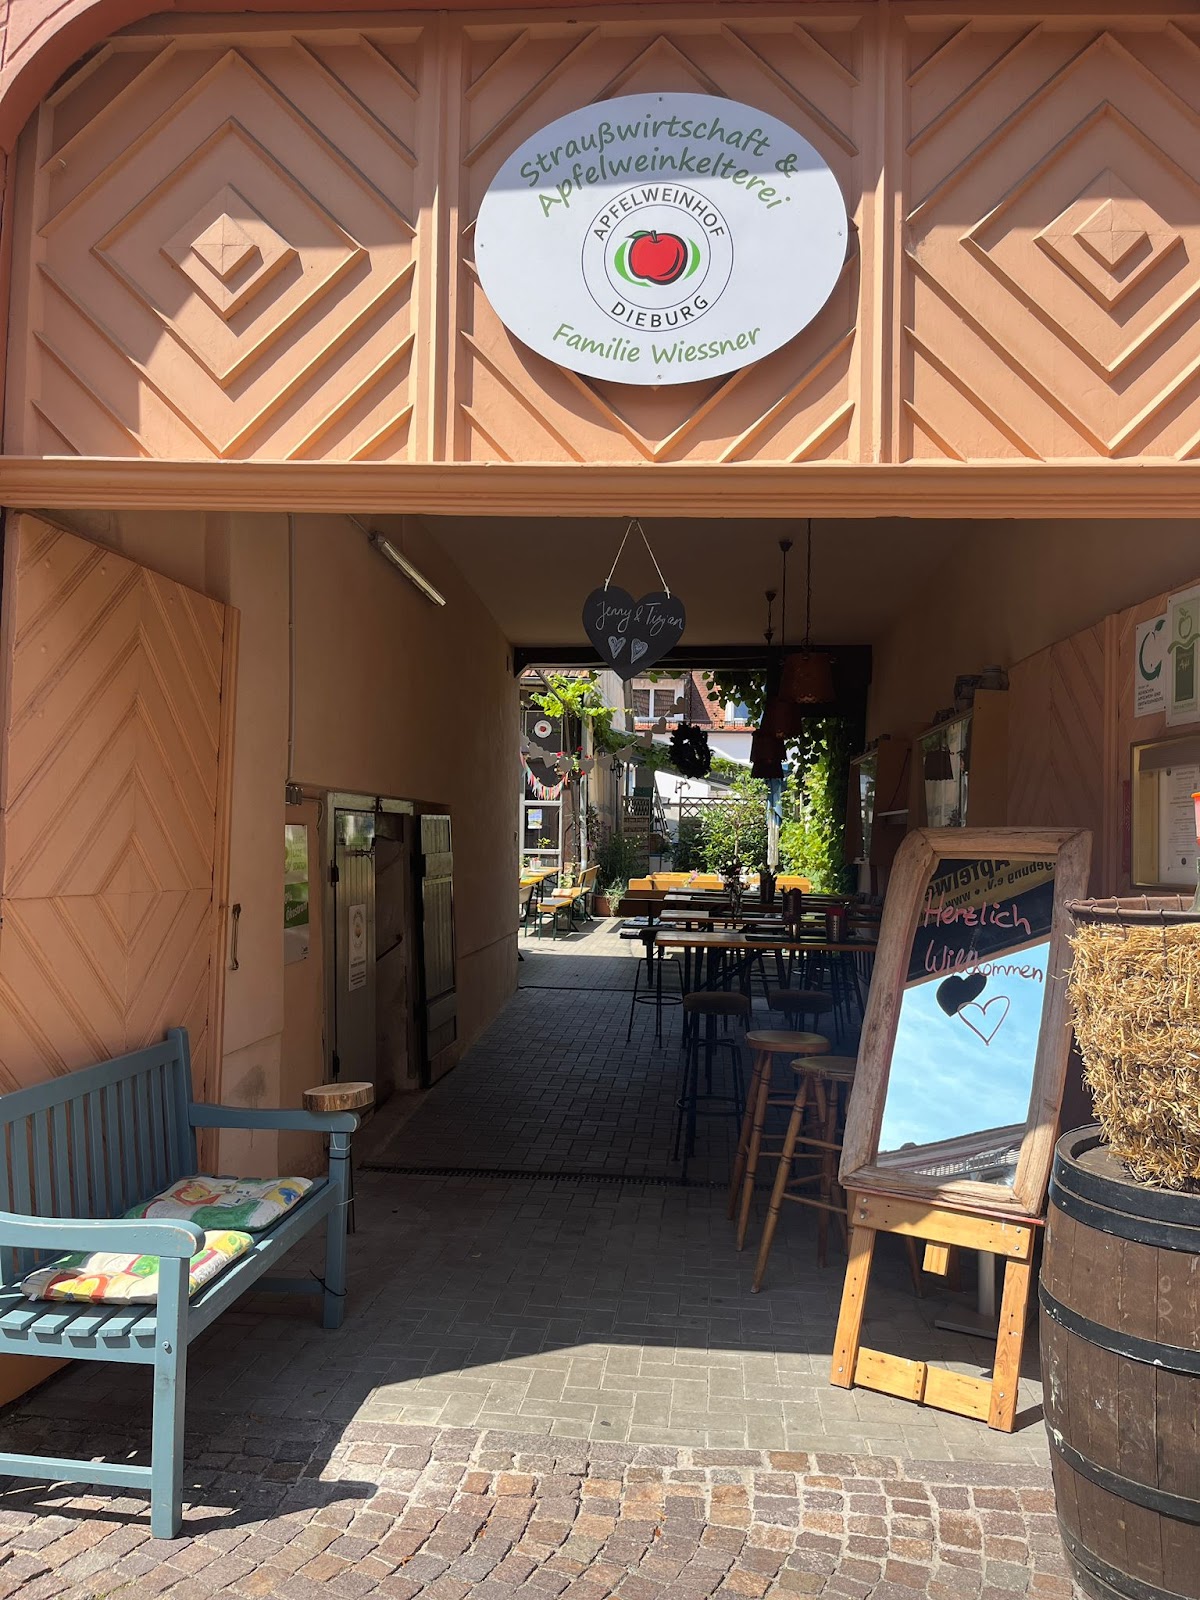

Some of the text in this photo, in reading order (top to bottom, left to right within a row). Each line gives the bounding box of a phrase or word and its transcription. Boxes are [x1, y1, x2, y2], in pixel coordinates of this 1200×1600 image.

[520, 114, 799, 187] Straußwirtschaft &
[538, 147, 791, 217] Apfelweinkelterei
[593, 187, 725, 241] APFELWEINHOF
[611, 295, 709, 328] DIEBURG
[552, 323, 761, 364] Familie Wiessner
[924, 888, 1031, 935] Herzlich
[925, 939, 1043, 982] Willkommen
